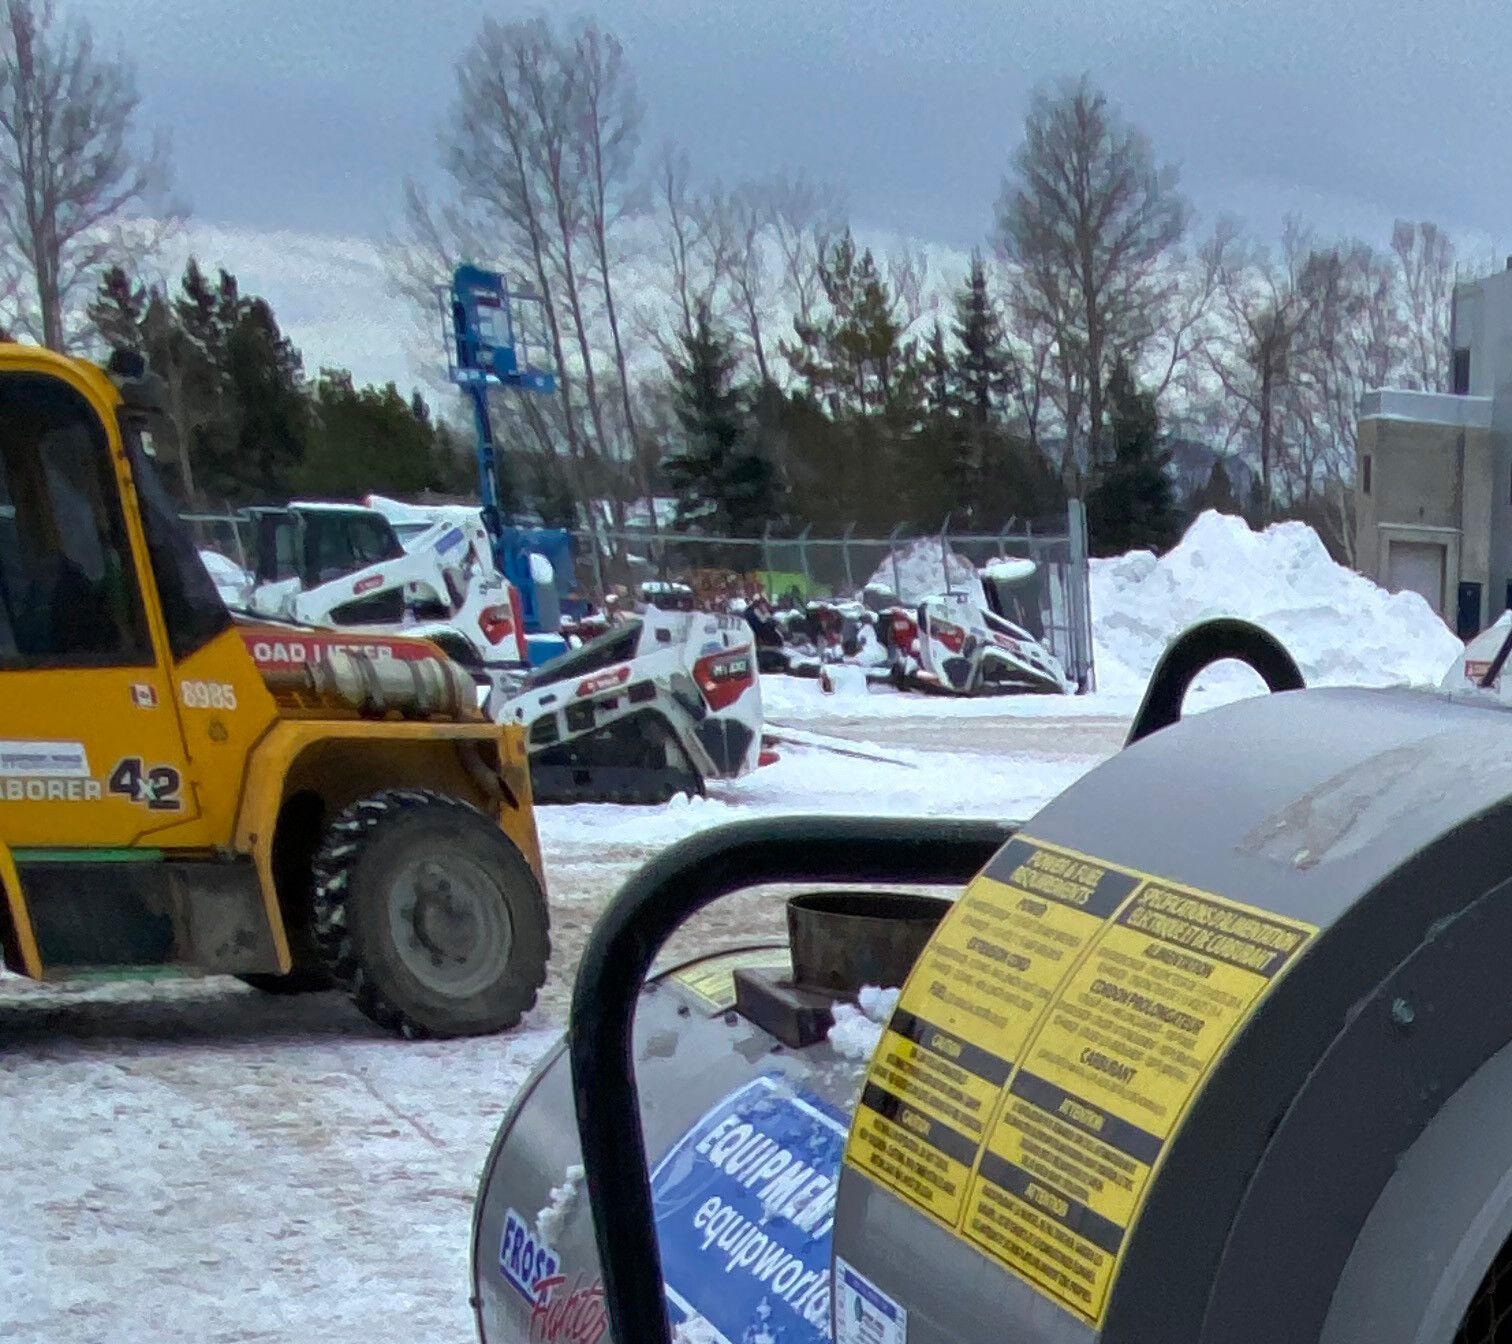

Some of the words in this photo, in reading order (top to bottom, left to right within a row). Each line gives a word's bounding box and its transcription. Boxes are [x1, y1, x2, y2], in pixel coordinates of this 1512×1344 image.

[250, 642, 306, 662] OAD
[180, 680, 237, 711] 8985
[696, 1114, 837, 1240] EQUIPMEN
